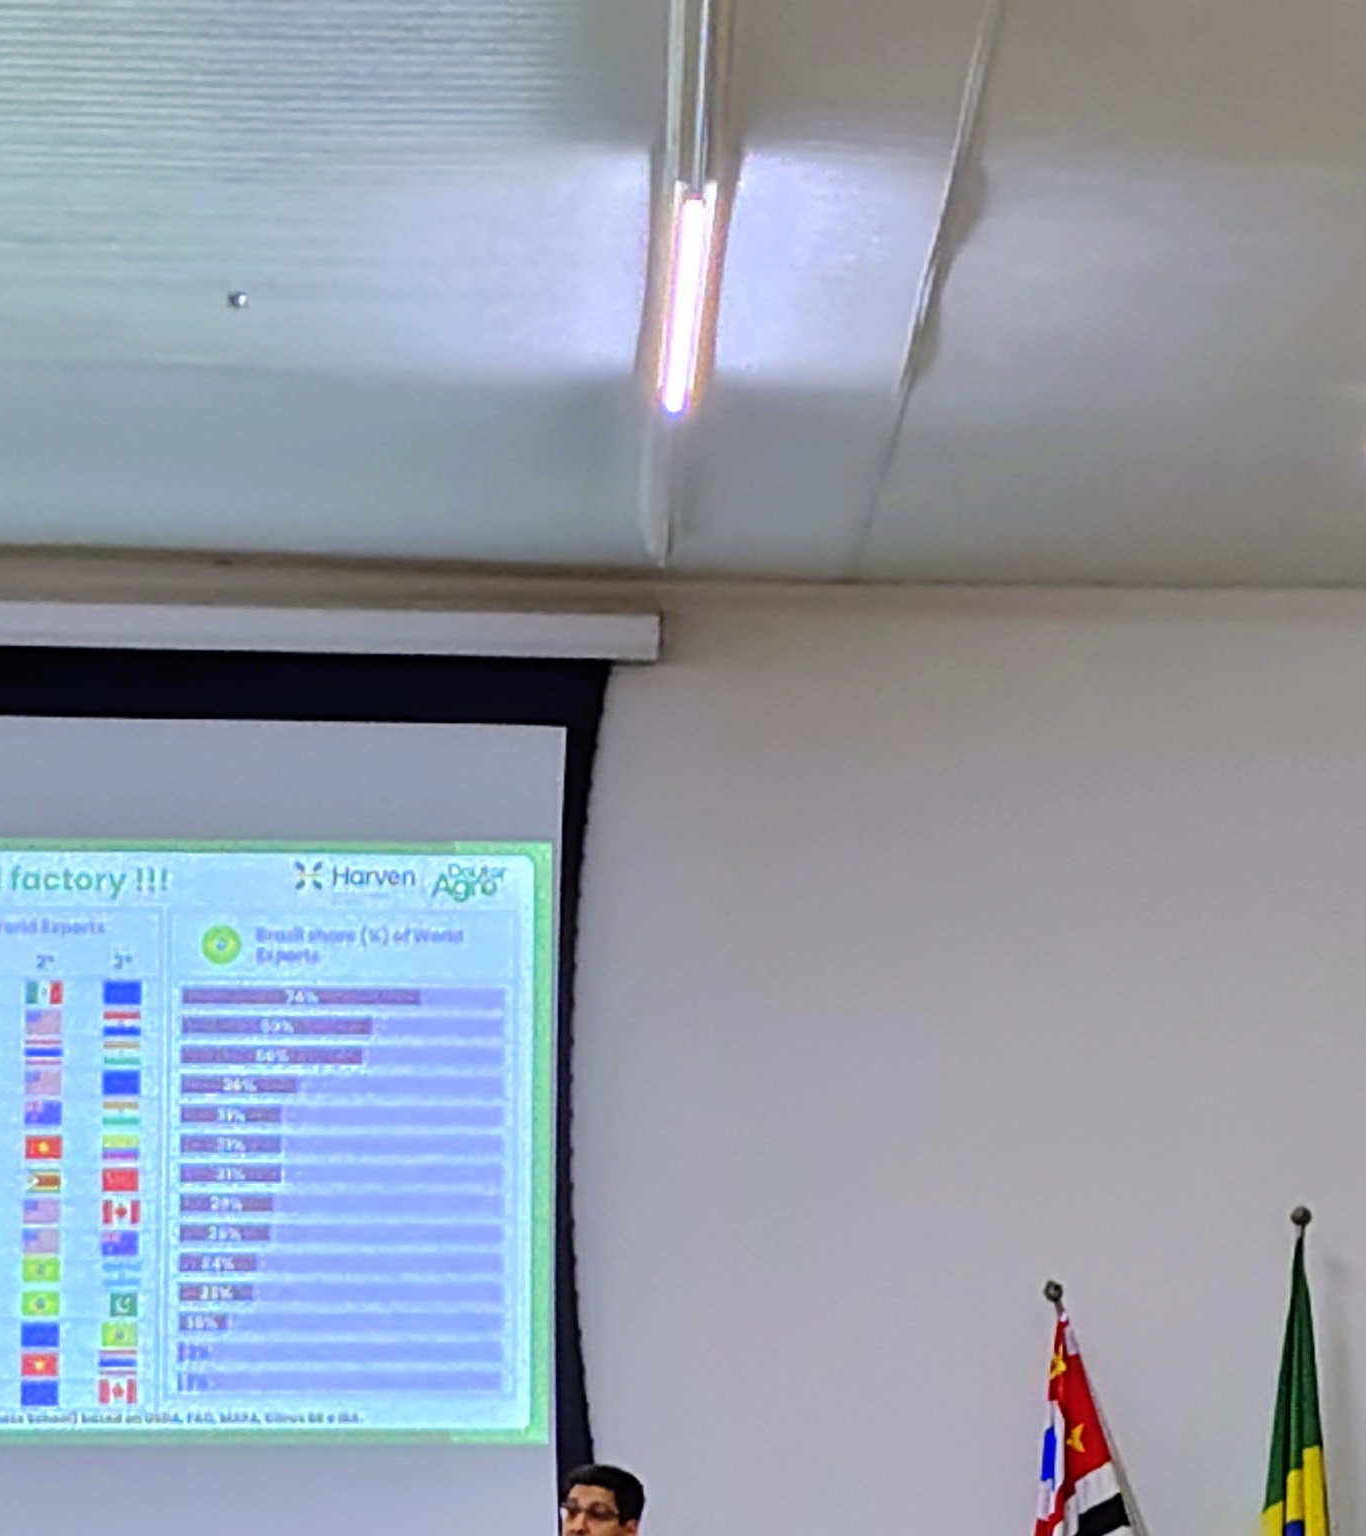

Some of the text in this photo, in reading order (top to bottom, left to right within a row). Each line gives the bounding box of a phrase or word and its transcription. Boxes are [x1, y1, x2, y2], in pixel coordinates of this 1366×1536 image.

[11, 866, 126, 899] factory
[136, 867, 168, 892] !!!
[332, 866, 416, 886] Harven
[447, 863, 507, 883] Doutor
[431, 873, 497, 902] Agro
[40, 918, 106, 937] Exports
[306, 926, 356, 942] share
[393, 926, 412, 942] of
[413, 926, 464, 942] World
[255, 947, 320, 966] Exports
